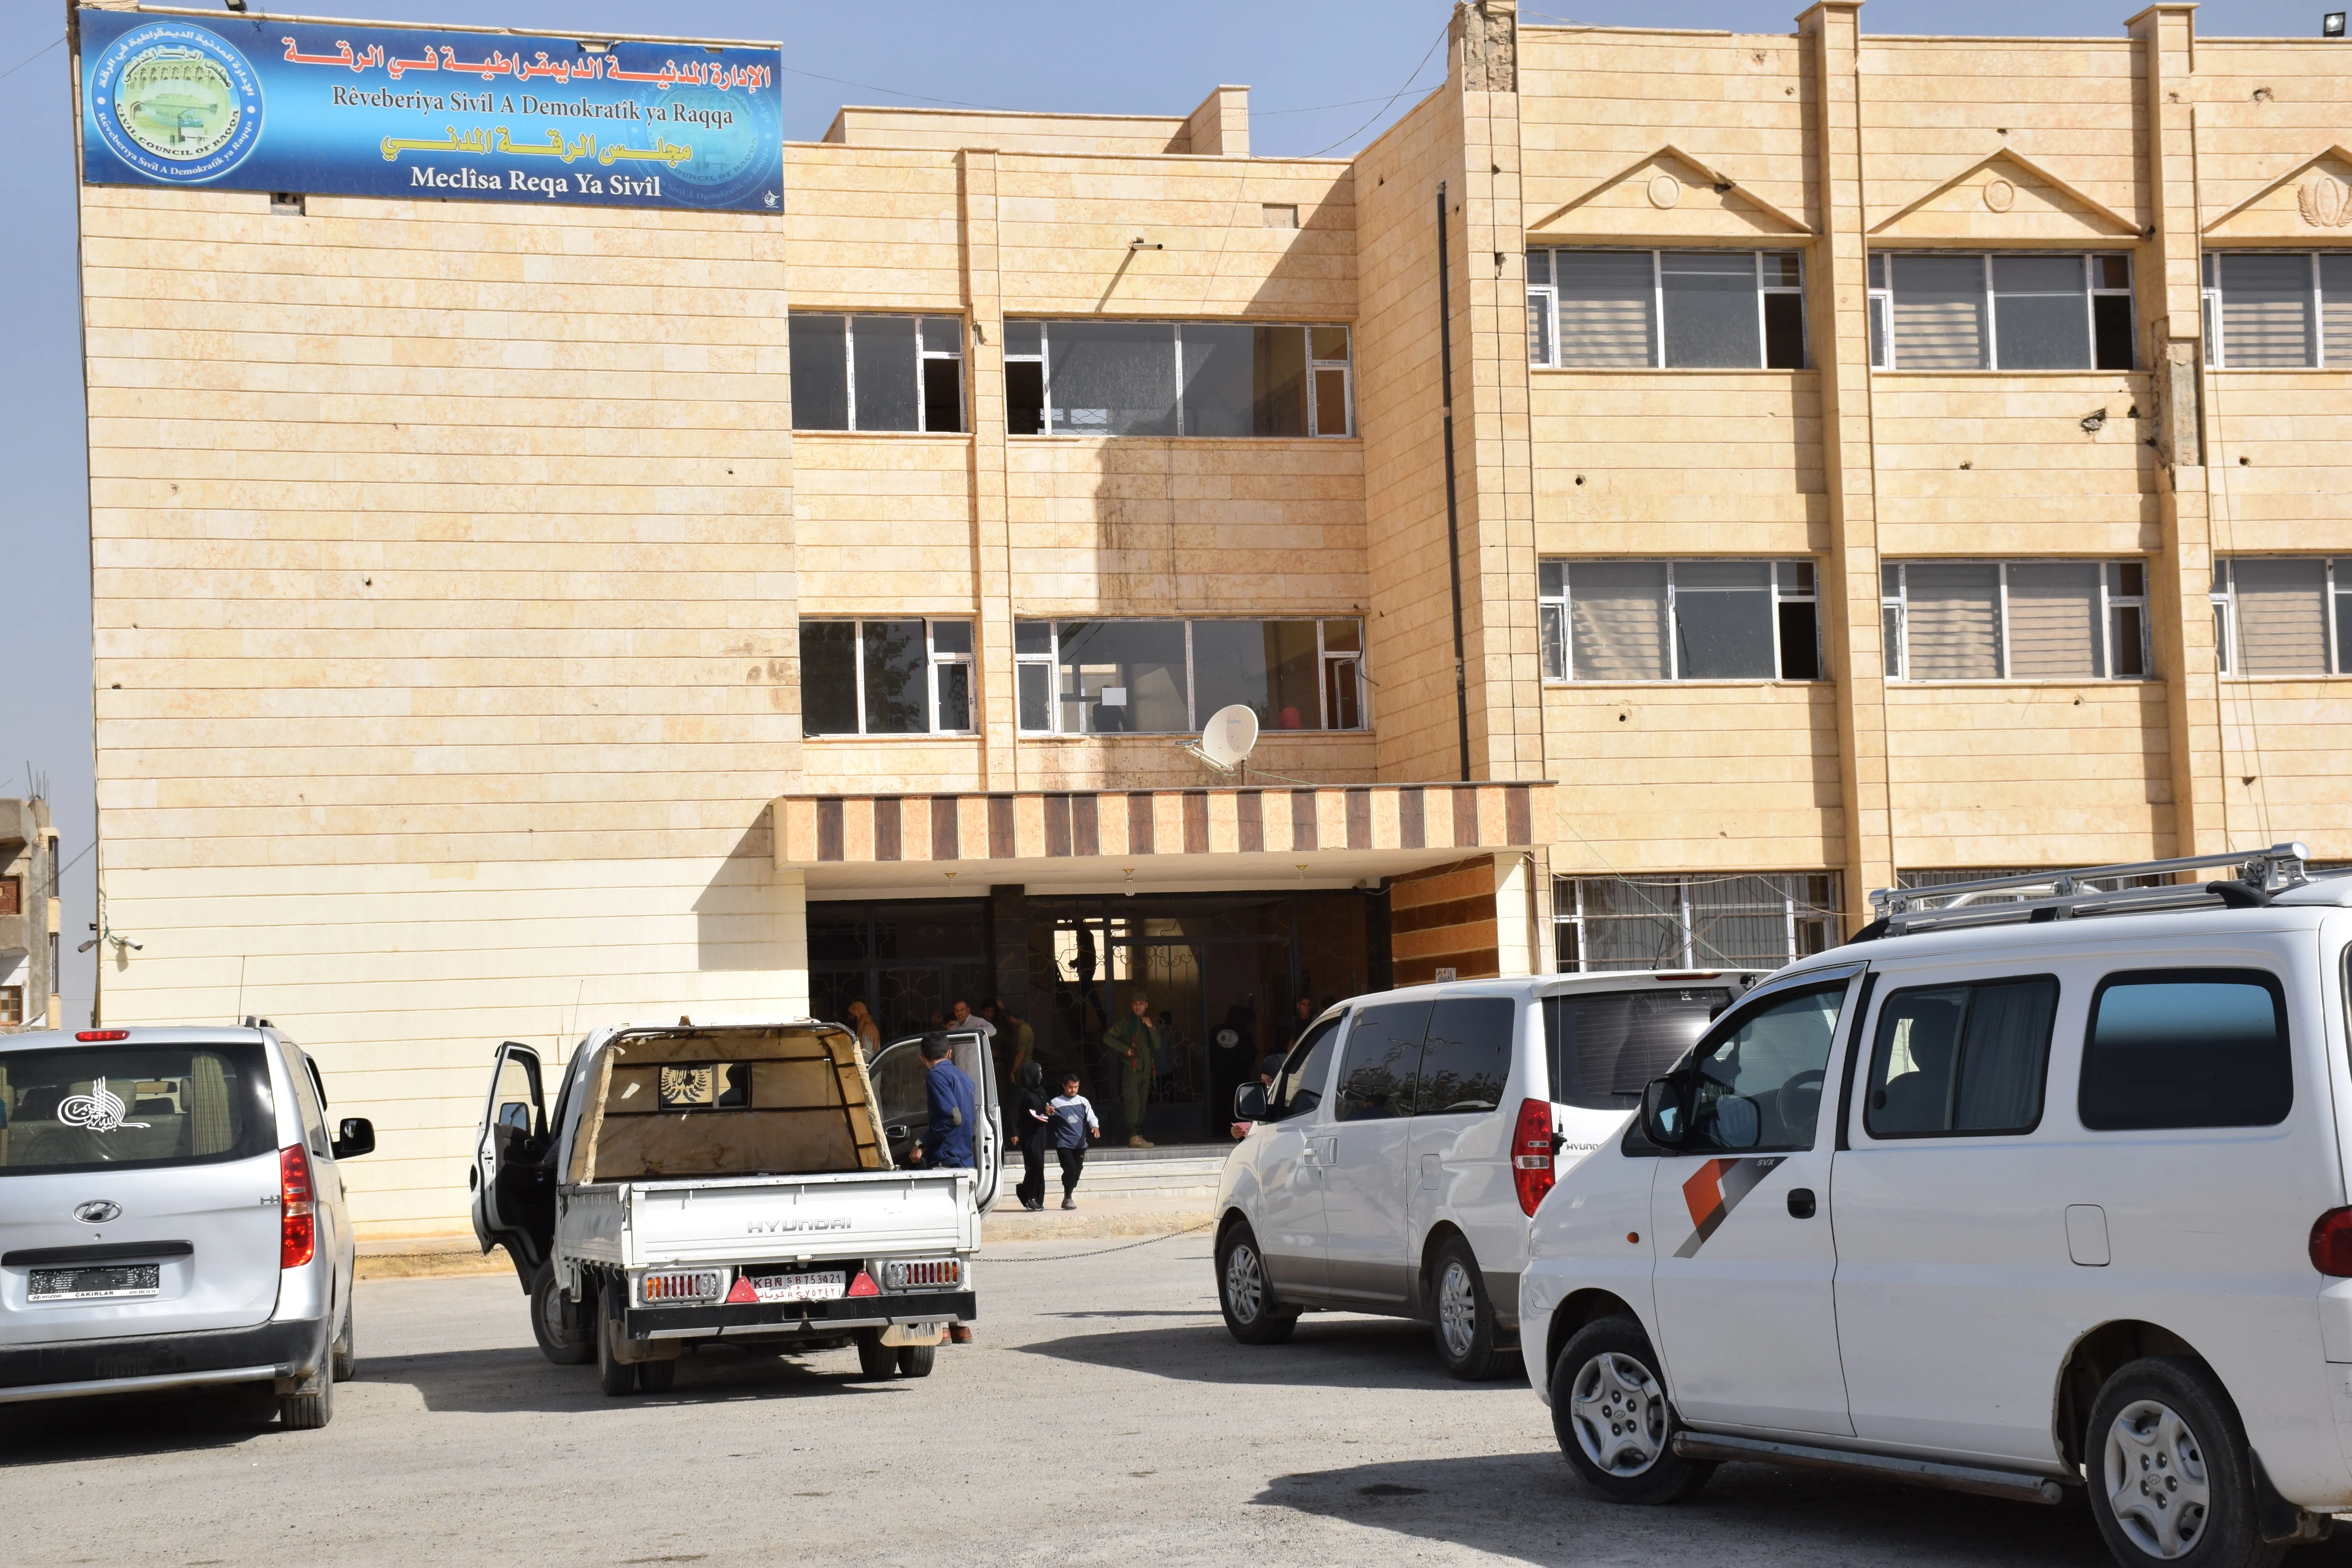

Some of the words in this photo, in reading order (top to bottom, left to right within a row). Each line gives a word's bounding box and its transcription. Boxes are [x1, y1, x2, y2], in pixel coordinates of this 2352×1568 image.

[281, 37, 383, 73] الرقة
[387, 45, 439, 80] في
[441, 45, 602, 83] الديمقراطية
[607, 54, 706, 89] المدنية
[711, 62, 771, 94] الإدارة
[332, 86, 445, 115] Rêveberiya
[450, 92, 493, 113] Sivîl
[499, 98, 515, 113] A
[521, 96, 641, 120] Demokratîk
[647, 107, 667, 126] ya
[673, 103, 733, 129] Raqqa
[116, 103, 137, 138] CIVIL
[138, 136, 193, 156] COUNCIL
[195, 144, 211, 154] OF
[212, 109, 240, 149] RAQQA
[381, 125, 492, 162] المدني
[495, 126, 595, 163] الرقة
[170, 156, 225, 176] Demokratîk
[223, 151, 234, 162] ya
[232, 121, 253, 151] Raqqa
[599, 137, 693, 168] مجلس
[410, 166, 503, 190] Meclîsa
[509, 170, 569, 198] Reqa
[575, 174, 603, 195] Ya
[610, 176, 661, 197] Sivîl
[748, 1217, 851, 1233] HYUNDAI
[804, 1274, 841, 1285] 753421
